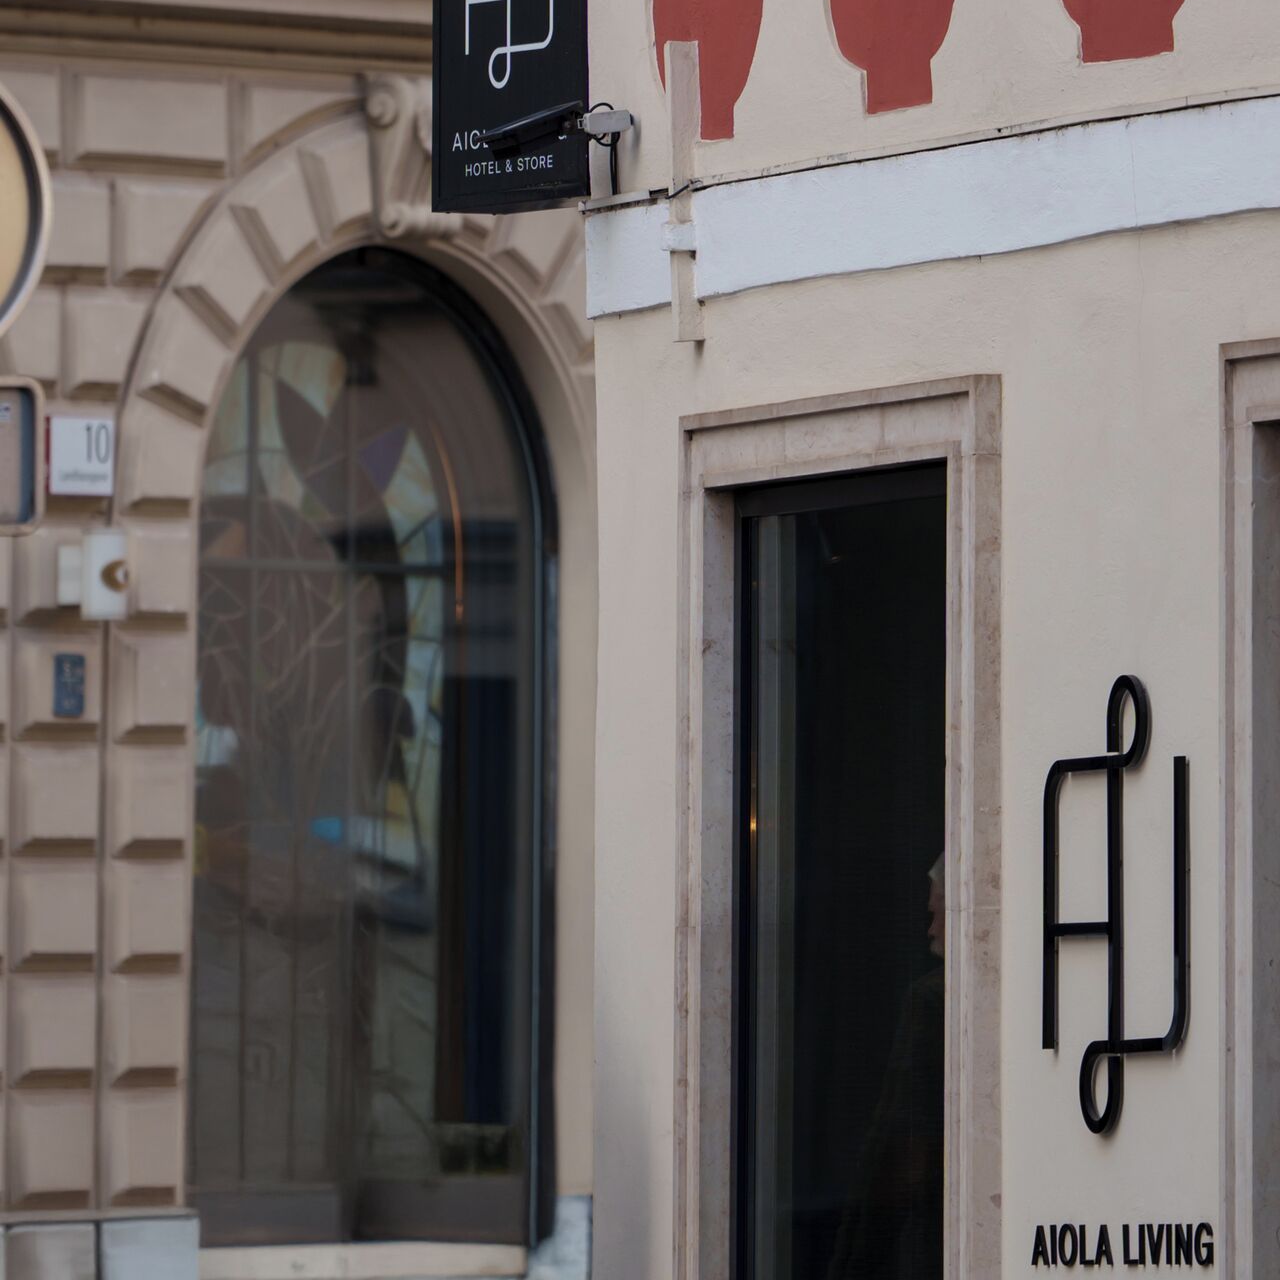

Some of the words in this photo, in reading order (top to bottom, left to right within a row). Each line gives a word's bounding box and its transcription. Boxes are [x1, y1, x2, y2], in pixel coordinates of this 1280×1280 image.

[464, 160, 502, 177] HOTEL
[505, 158, 513, 173] &
[517, 154, 554, 171] STORE
[85, 422, 111, 465] 10
[1031, 1223, 1114, 1267] AIOLA
[1121, 1222, 1215, 1267] LIVING
